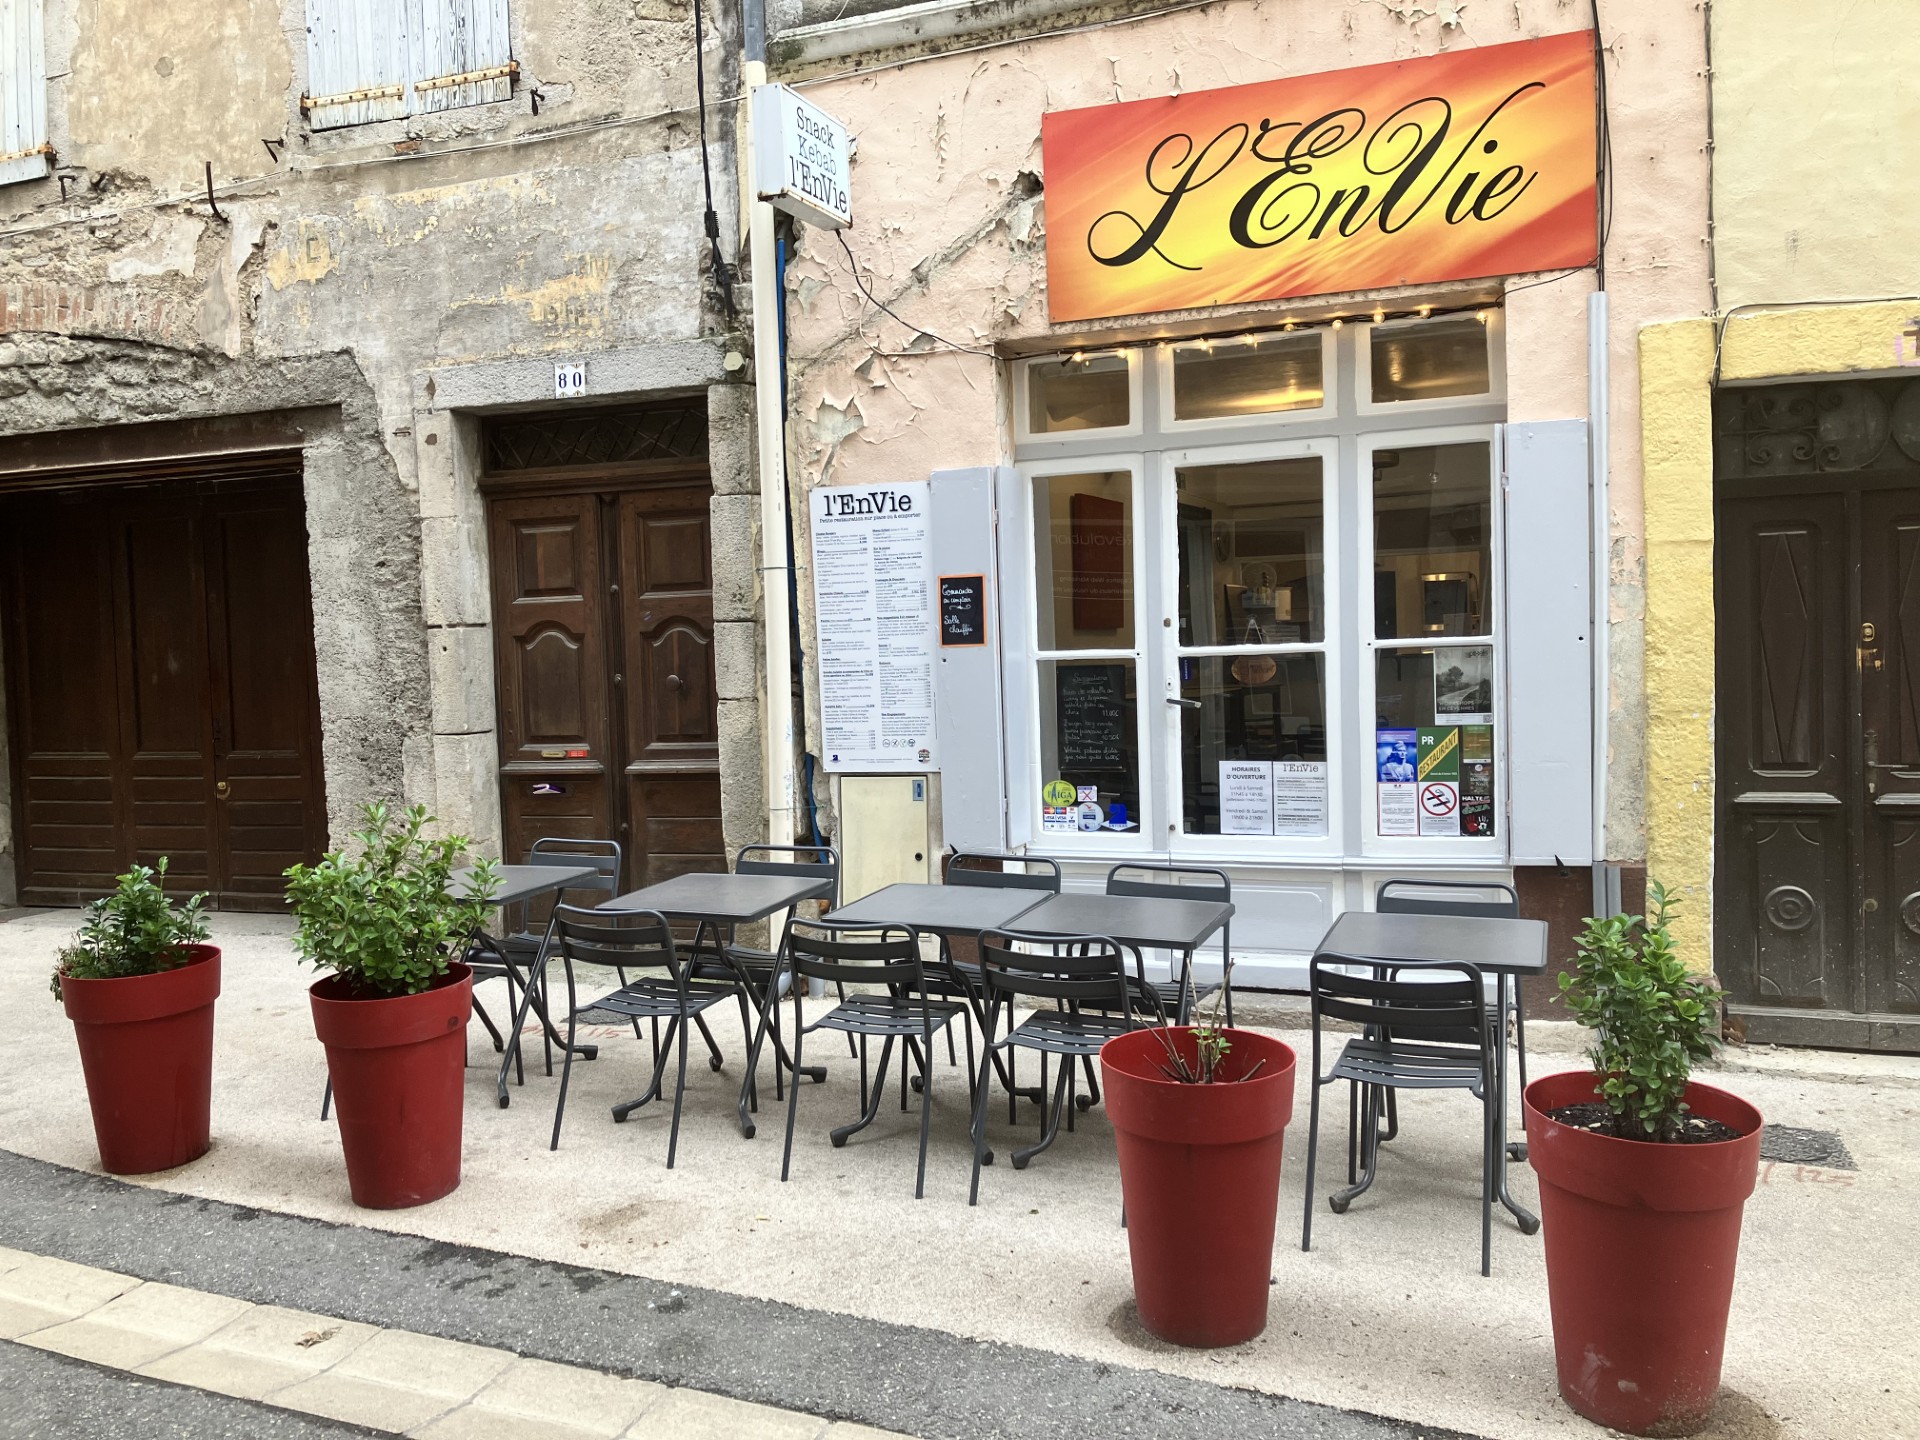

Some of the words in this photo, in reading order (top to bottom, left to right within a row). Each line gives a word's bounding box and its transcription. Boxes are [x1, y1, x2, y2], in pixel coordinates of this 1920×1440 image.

[796, 106, 835, 149] Snack
[797, 133, 837, 175] Kebab
[789, 155, 848, 213] l'EnVie
[1087, 82, 1547, 270] L'EnVie
[558, 371, 582, 389] 80
[823, 491, 912, 516] l'EnVie
[1418, 731, 1457, 777] RESTAURANT
[1421, 735, 1434, 745] PR
[1283, 763, 1319, 772] l'EnVie
